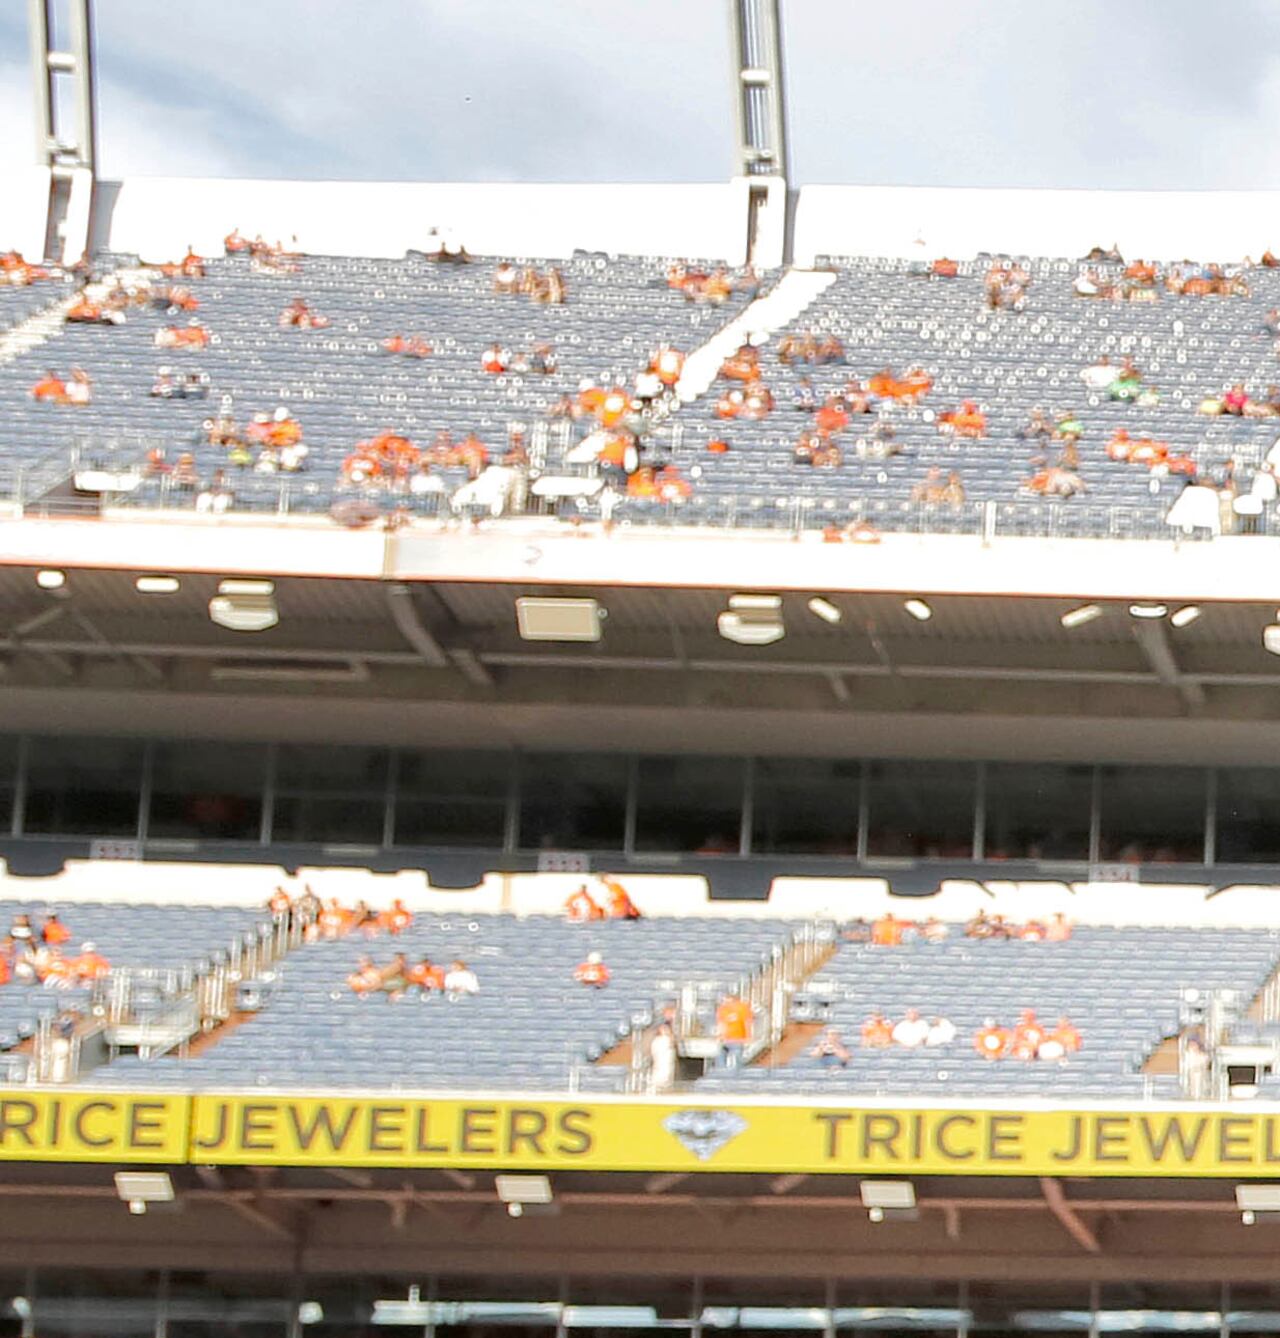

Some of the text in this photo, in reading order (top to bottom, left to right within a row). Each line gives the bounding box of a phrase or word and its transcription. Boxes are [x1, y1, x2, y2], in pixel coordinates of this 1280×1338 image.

[0, 1100, 593, 1155] RICE JEWELERS
[815, 1113, 1024, 1162] TRICE
